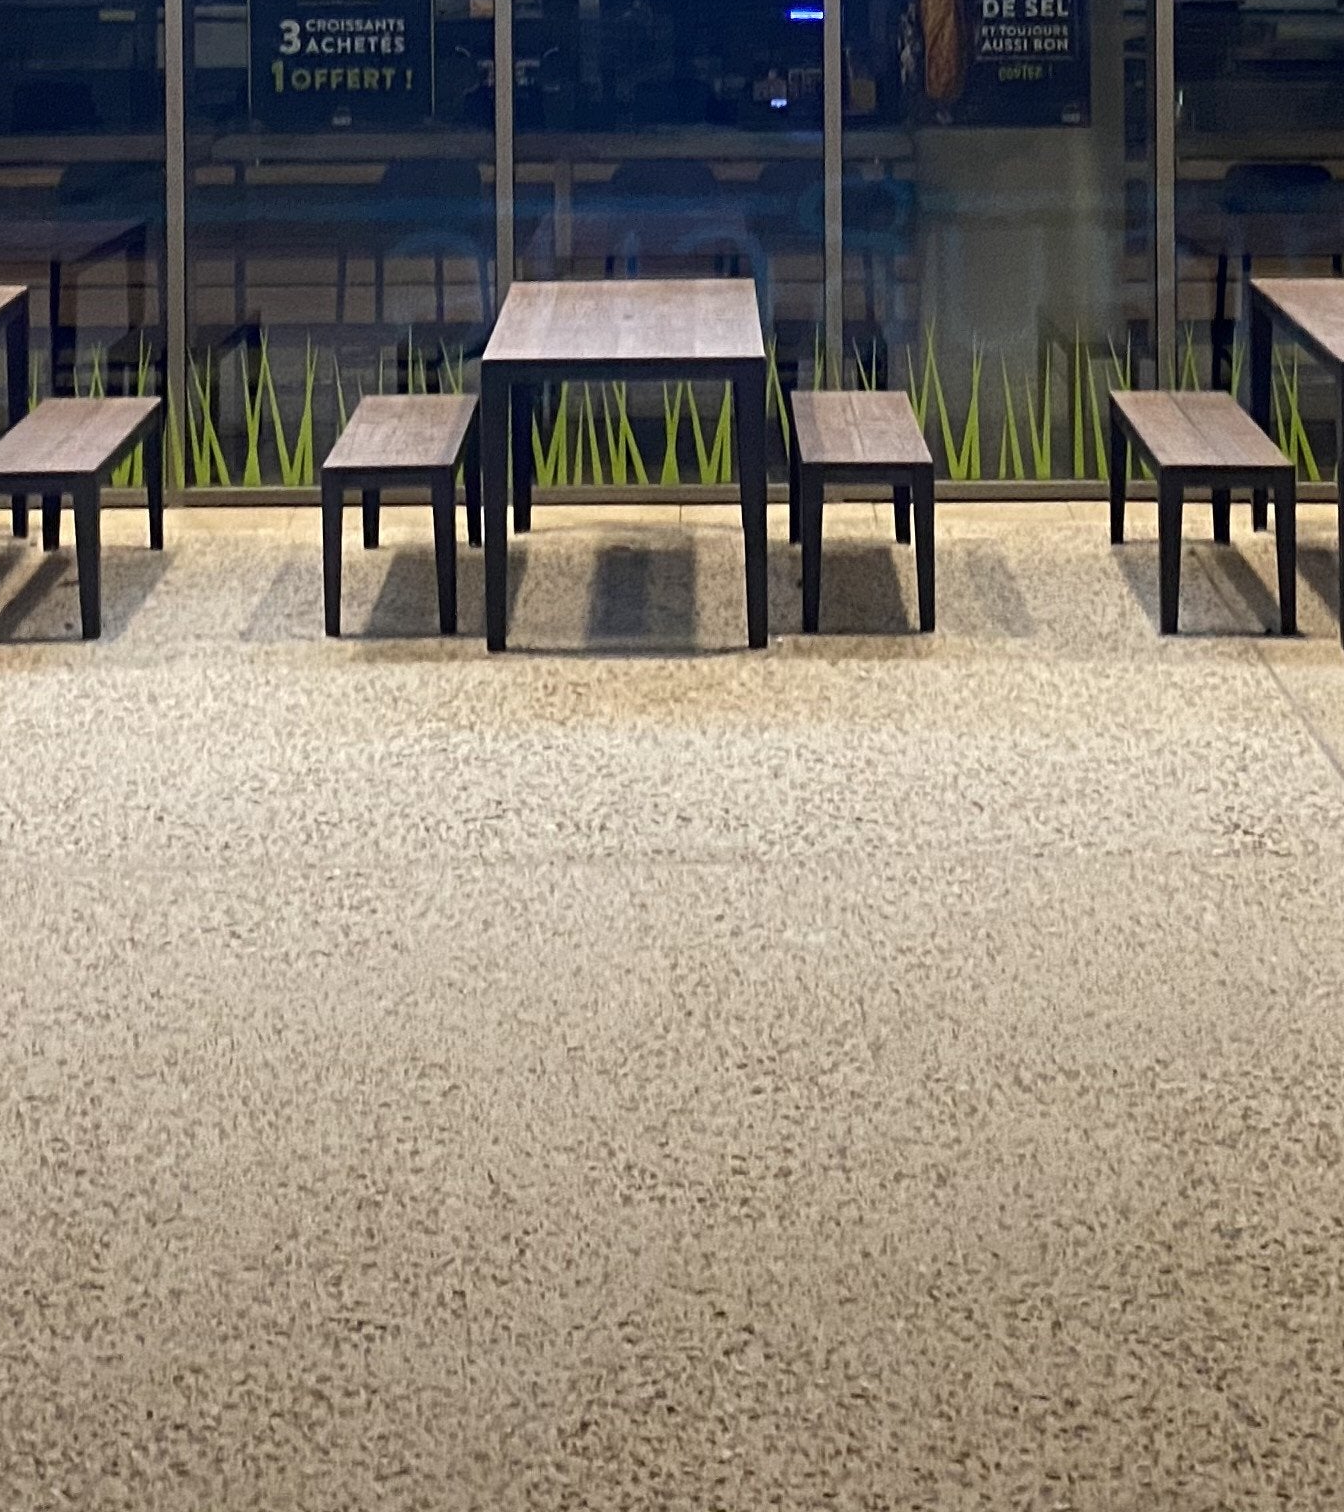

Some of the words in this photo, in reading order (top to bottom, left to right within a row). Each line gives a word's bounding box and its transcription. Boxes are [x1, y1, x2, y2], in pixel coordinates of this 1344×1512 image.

[279, 18, 302, 55] 3
[304, 17, 406, 33] CROISSANTS
[304, 32, 406, 55] ACHETÉS
[290, 67, 397, 92] OFFERT
